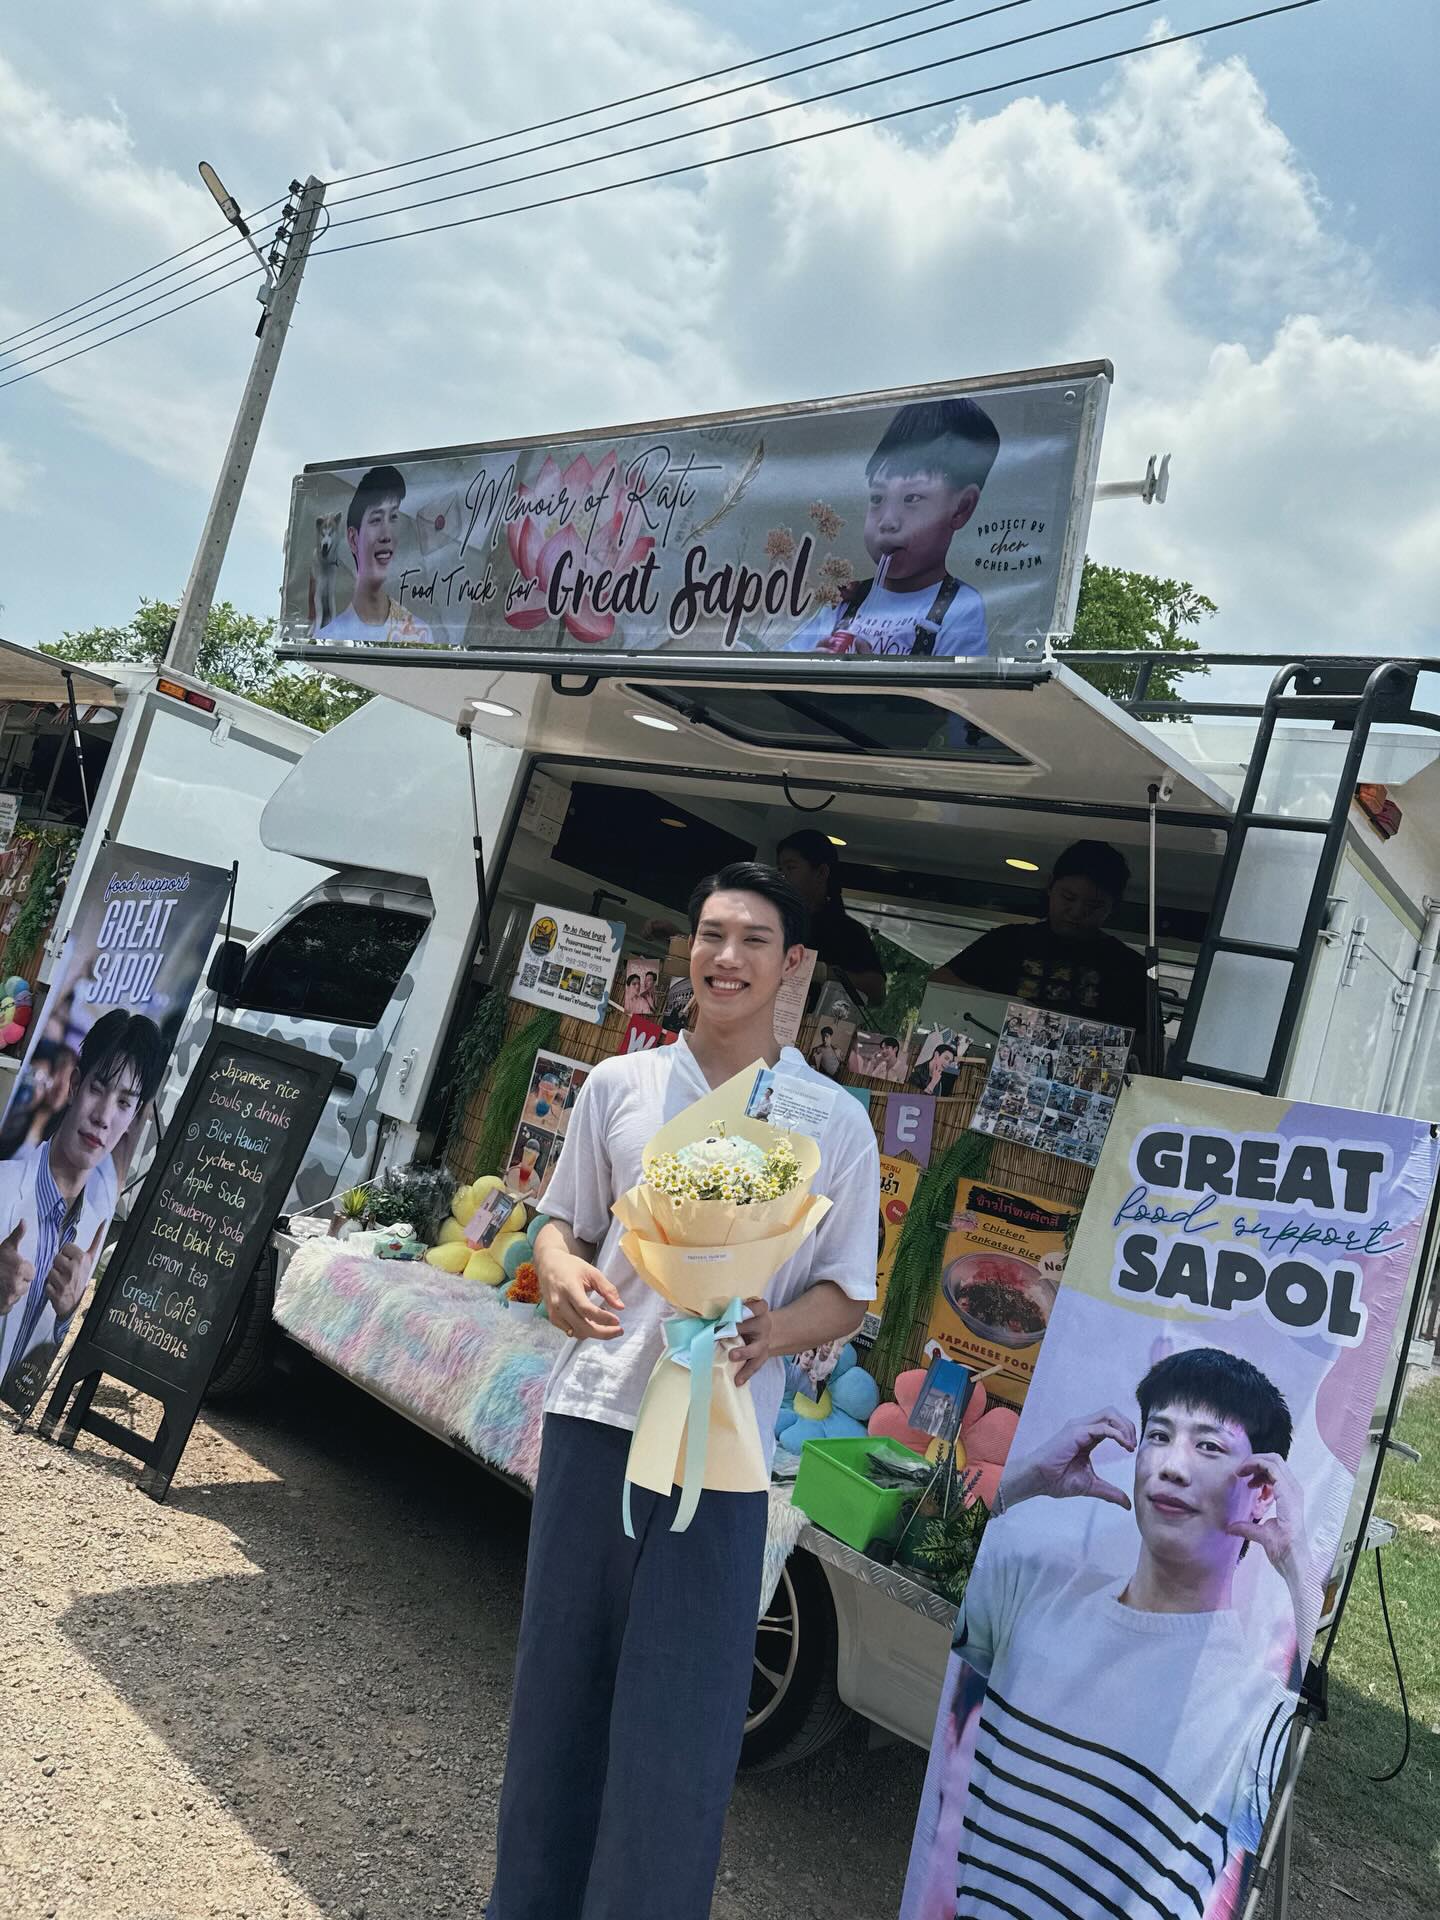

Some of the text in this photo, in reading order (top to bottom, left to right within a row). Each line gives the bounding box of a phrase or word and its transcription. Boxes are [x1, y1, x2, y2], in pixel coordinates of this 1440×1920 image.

[459, 465, 580, 557] Memoir
[584, 466, 616, 555] of
[617, 445, 722, 549] Rati
[977, 519, 1026, 537] PROJECT
[990, 529, 1030, 556] cher
[974, 555, 1043, 572] @CHER_PJM
[399, 536, 814, 648] Food Truck for Great Sapol
[104, 871, 190, 901] food support
[97, 899, 179, 950] GREAT
[87, 953, 165, 1005] SAPOL
[220, 1058, 301, 1100] Japanese rice
[208, 1088, 242, 1114] bowls
[253, 1101, 292, 1130] drinks
[896, 1105, 921, 1143] E
[206, 1118, 272, 1155] Blue Hawaii
[197, 1145, 264, 1184] Lychee Soda
[1136, 1131, 1385, 1215] GREAT
[182, 1167, 246, 1209] Apple Soda
[159, 1189, 246, 1244] Strawberry Soda
[982, 1222, 1026, 1241] Chicken
[1113, 1186, 1404, 1254] food support
[151, 1216, 236, 1268] Iced black tea
[965, 1231, 1042, 1261] Tonkatsu Rice
[188, 1261, 210, 1289] tea
[1044, 1261, 1065, 1272] Ne
[1118, 1234, 1362, 1338] SAPOL
[122, 1275, 162, 1312] Great
[938, 1332, 1001, 1361] JAPANESE
